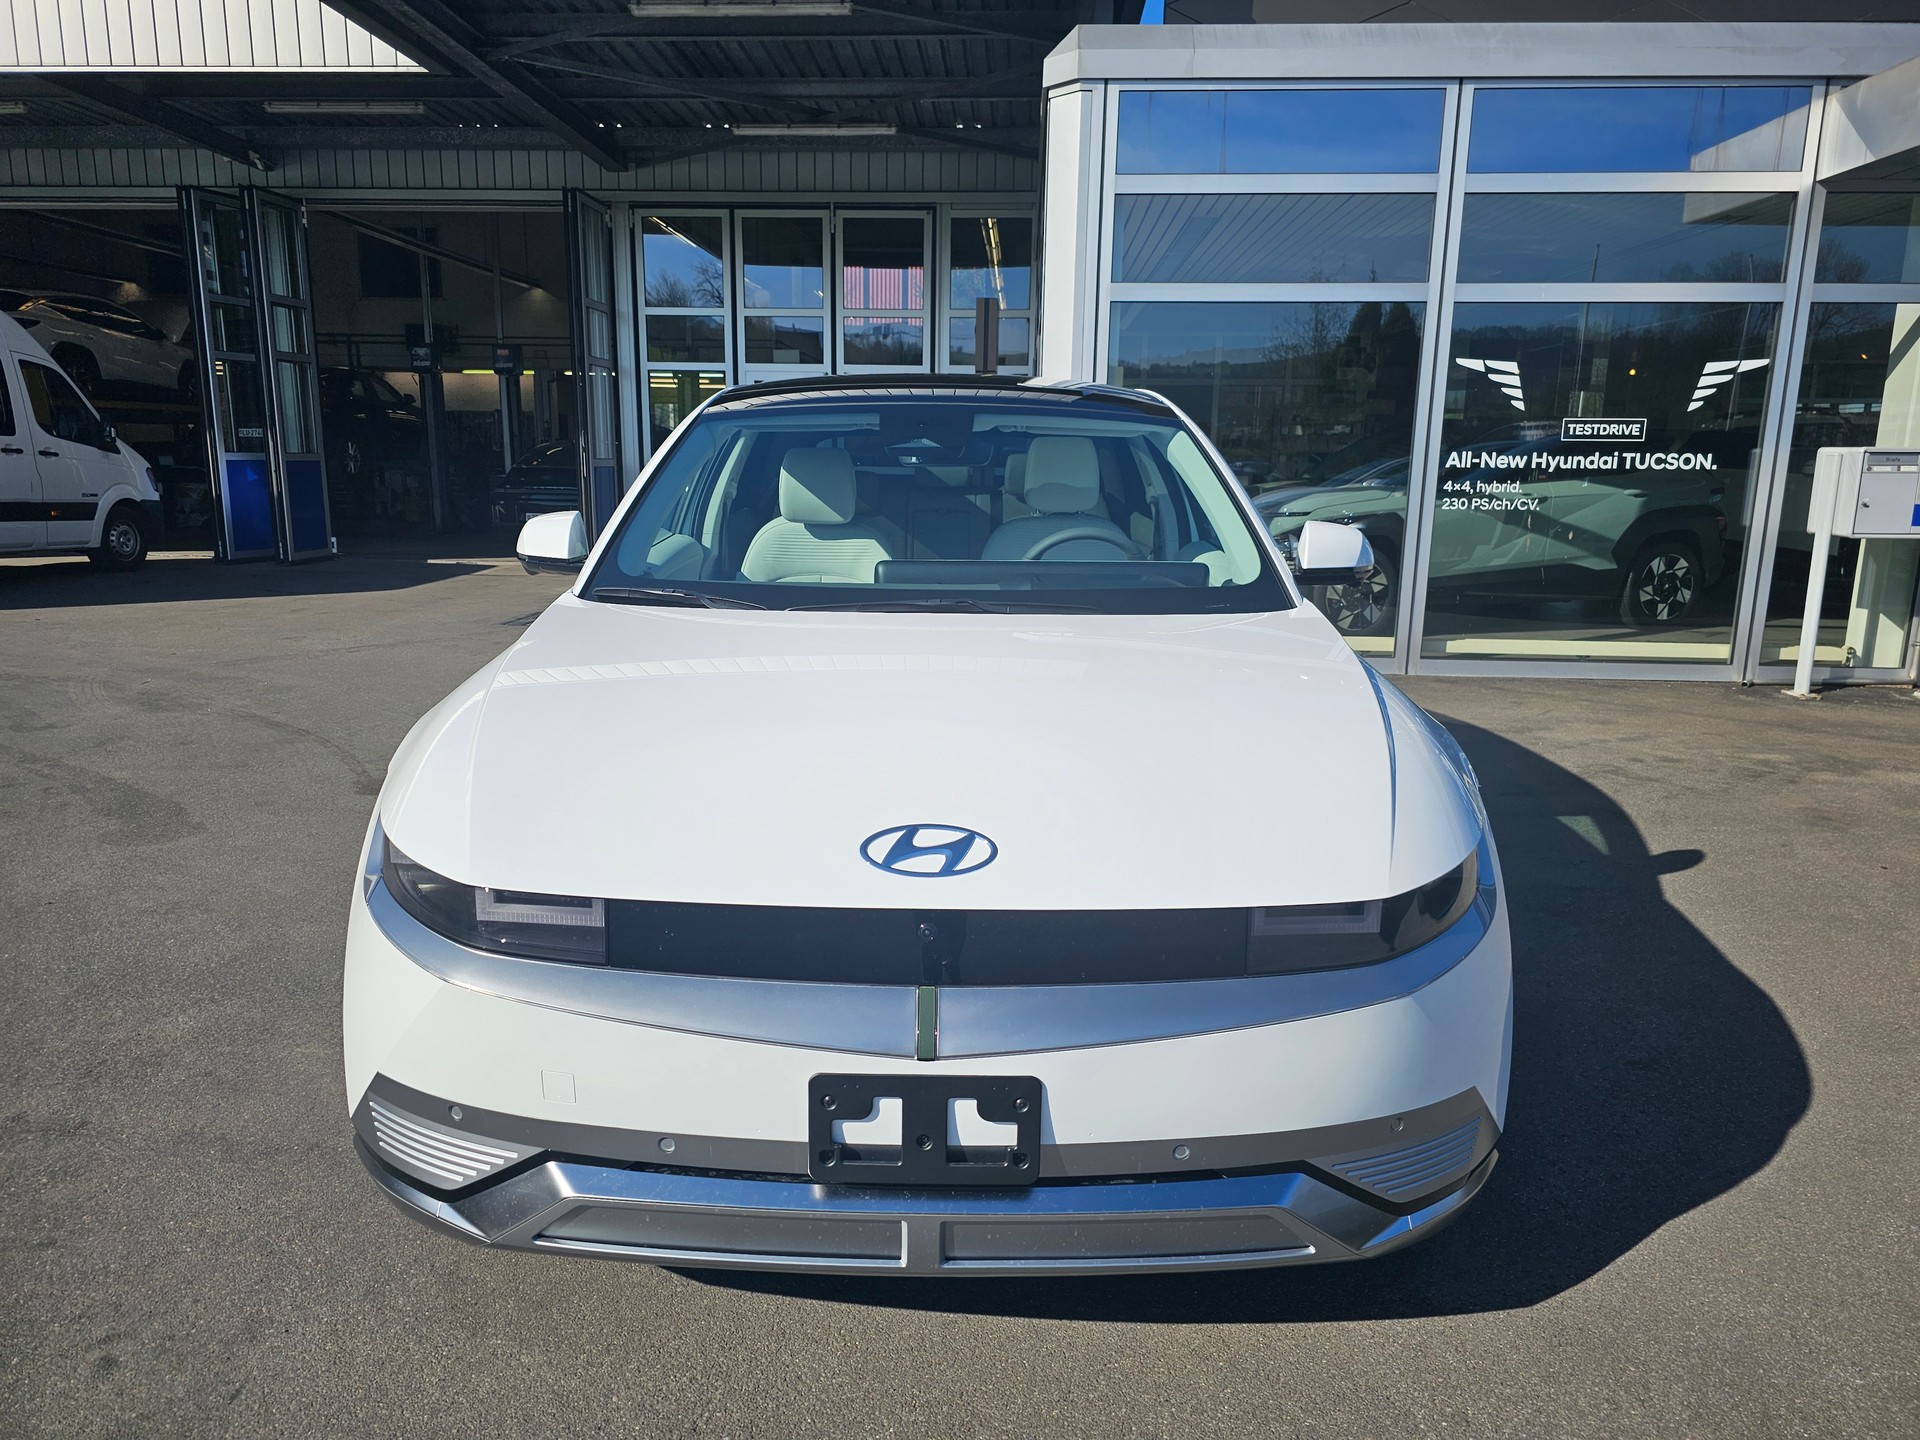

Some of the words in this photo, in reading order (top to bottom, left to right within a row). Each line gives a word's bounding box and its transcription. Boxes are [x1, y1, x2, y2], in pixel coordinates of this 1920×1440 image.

[1567, 423, 1641, 436] TESTDRIVE
[1445, 450, 1528, 469] All-New
[1531, 451, 1619, 473] Hyundai
[1622, 452, 1718, 470] TUCSON.
[1476, 480, 1523, 495] hybrid.
[1441, 497, 1468, 510] 230
[1471, 498, 1540, 511] PS/ch/CV.
